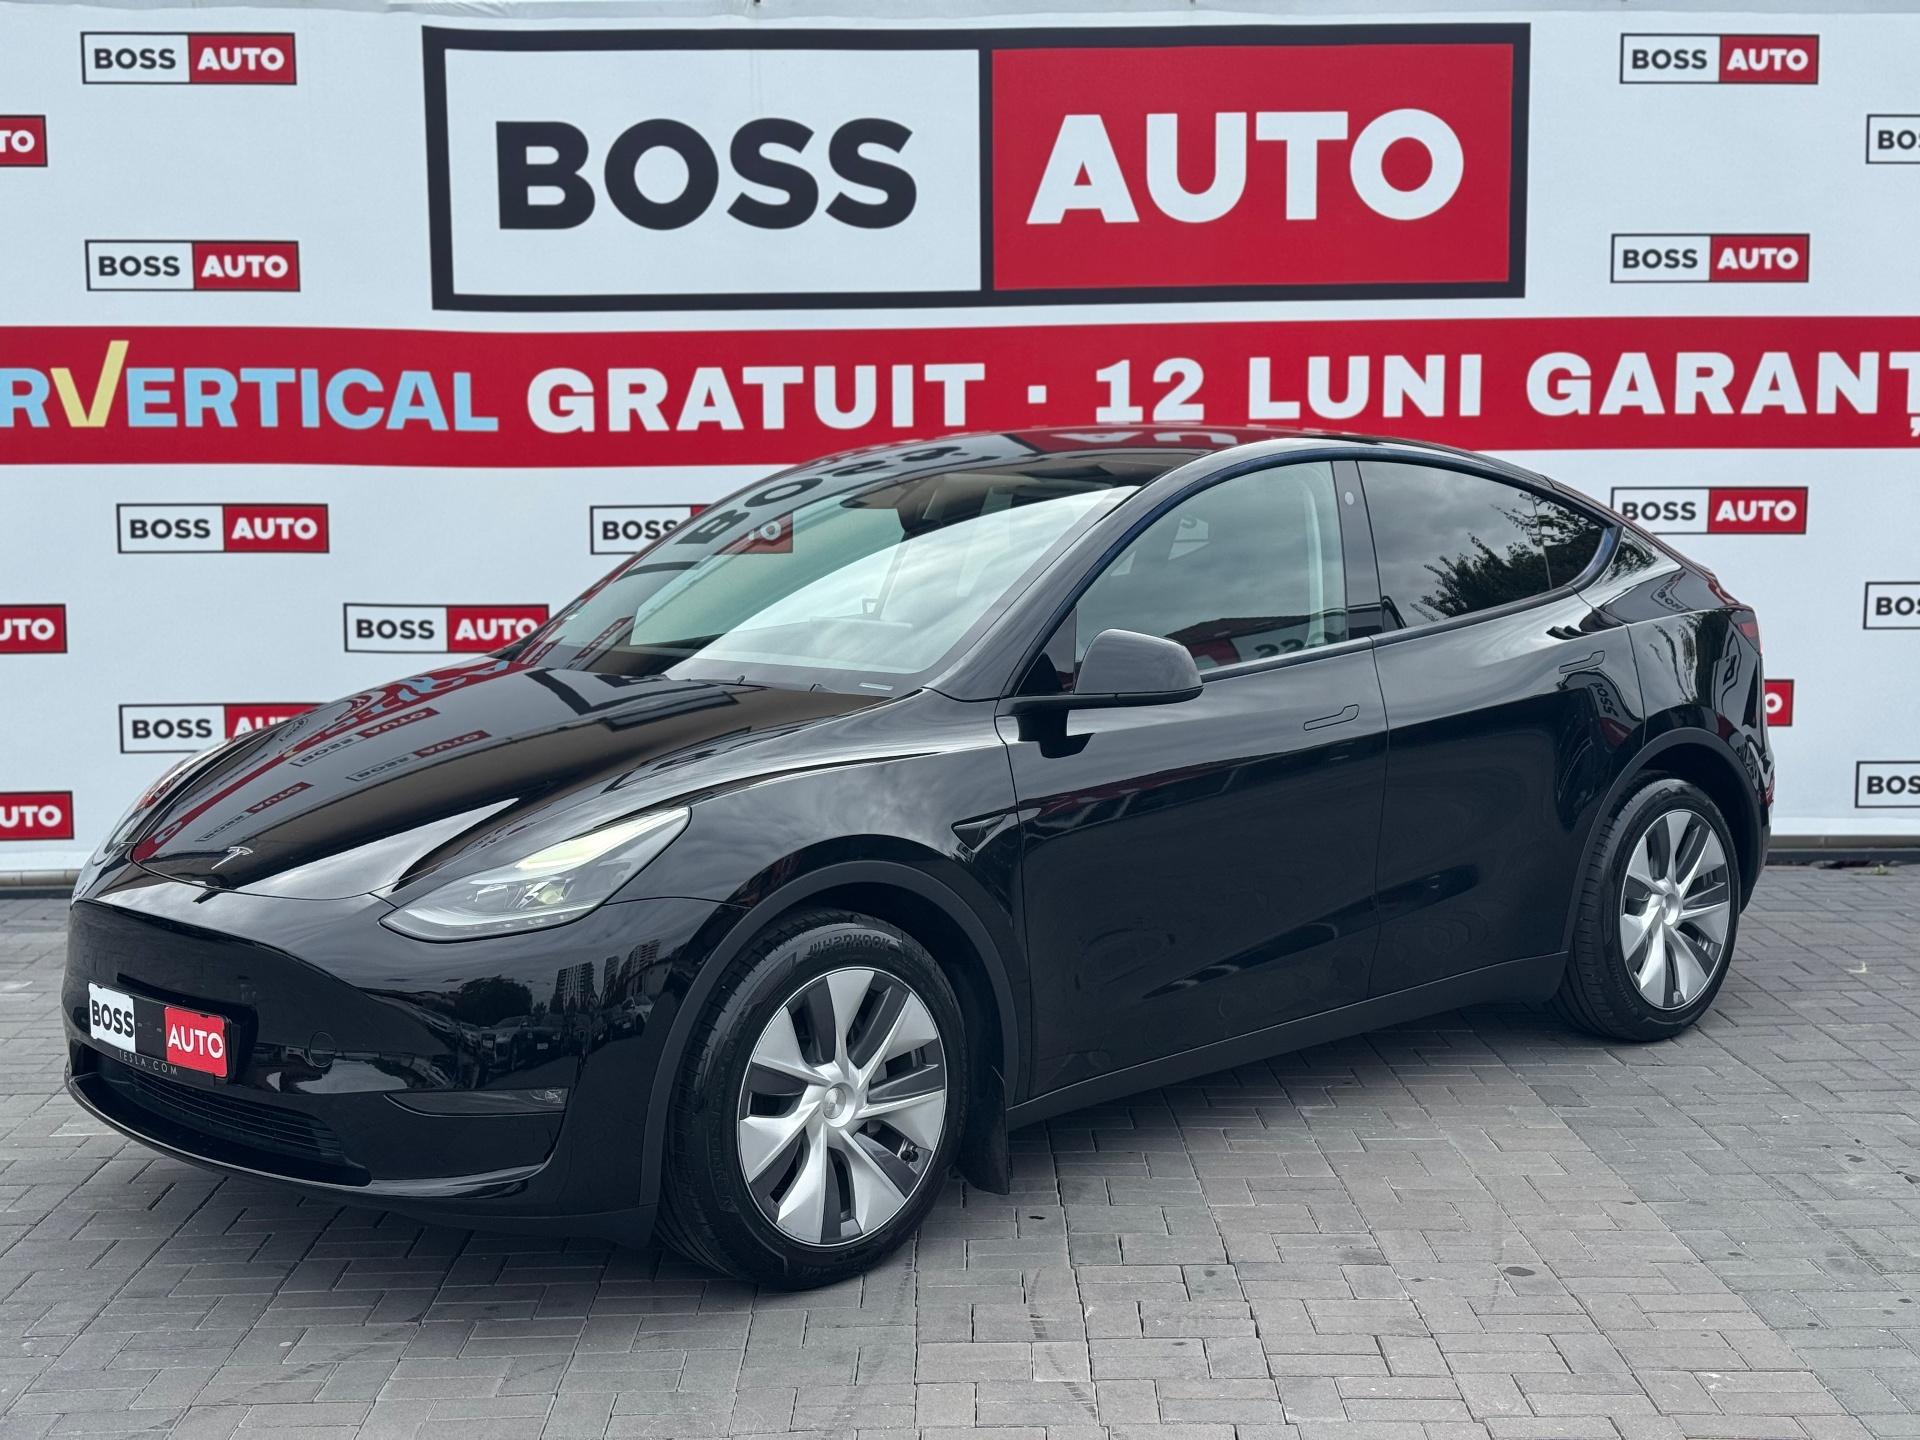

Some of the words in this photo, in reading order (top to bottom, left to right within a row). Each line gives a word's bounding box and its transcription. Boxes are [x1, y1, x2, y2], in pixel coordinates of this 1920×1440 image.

[94, 48, 176, 70] BOSS
[197, 46, 285, 72] AUTO
[1631, 49, 1708, 70] BOSS
[1726, 47, 1809, 72] AUTO
[1877, 130, 1920, 150] BO
[496, 118, 916, 230] BOSS
[1027, 109, 1464, 224] AUTO
[98, 255, 180, 277] BOSS
[201, 254, 289, 279] AUTO
[1622, 248, 1698, 269] BOSS
[1717, 247, 1800, 270] AUTO
[527, 363, 985, 433] GRATUIT
[1096, 357, 1205, 422] 12
[1247, 354, 1481, 421] LUNI
[1621, 501, 1697, 522] BOSS
[1715, 499, 1797, 522] AUTO
[129, 518, 211, 539] BOSS
[231, 517, 318, 540] AUTO
[356, 618, 435, 640] BOSS
[454, 617, 537, 642] AUTO
[132, 718, 213, 739] BOSS
[91, 999, 135, 1038] BOSS
[167, 1023, 224, 1059] AUTO
[118, 1050, 178, 1076] TESLA.COM
